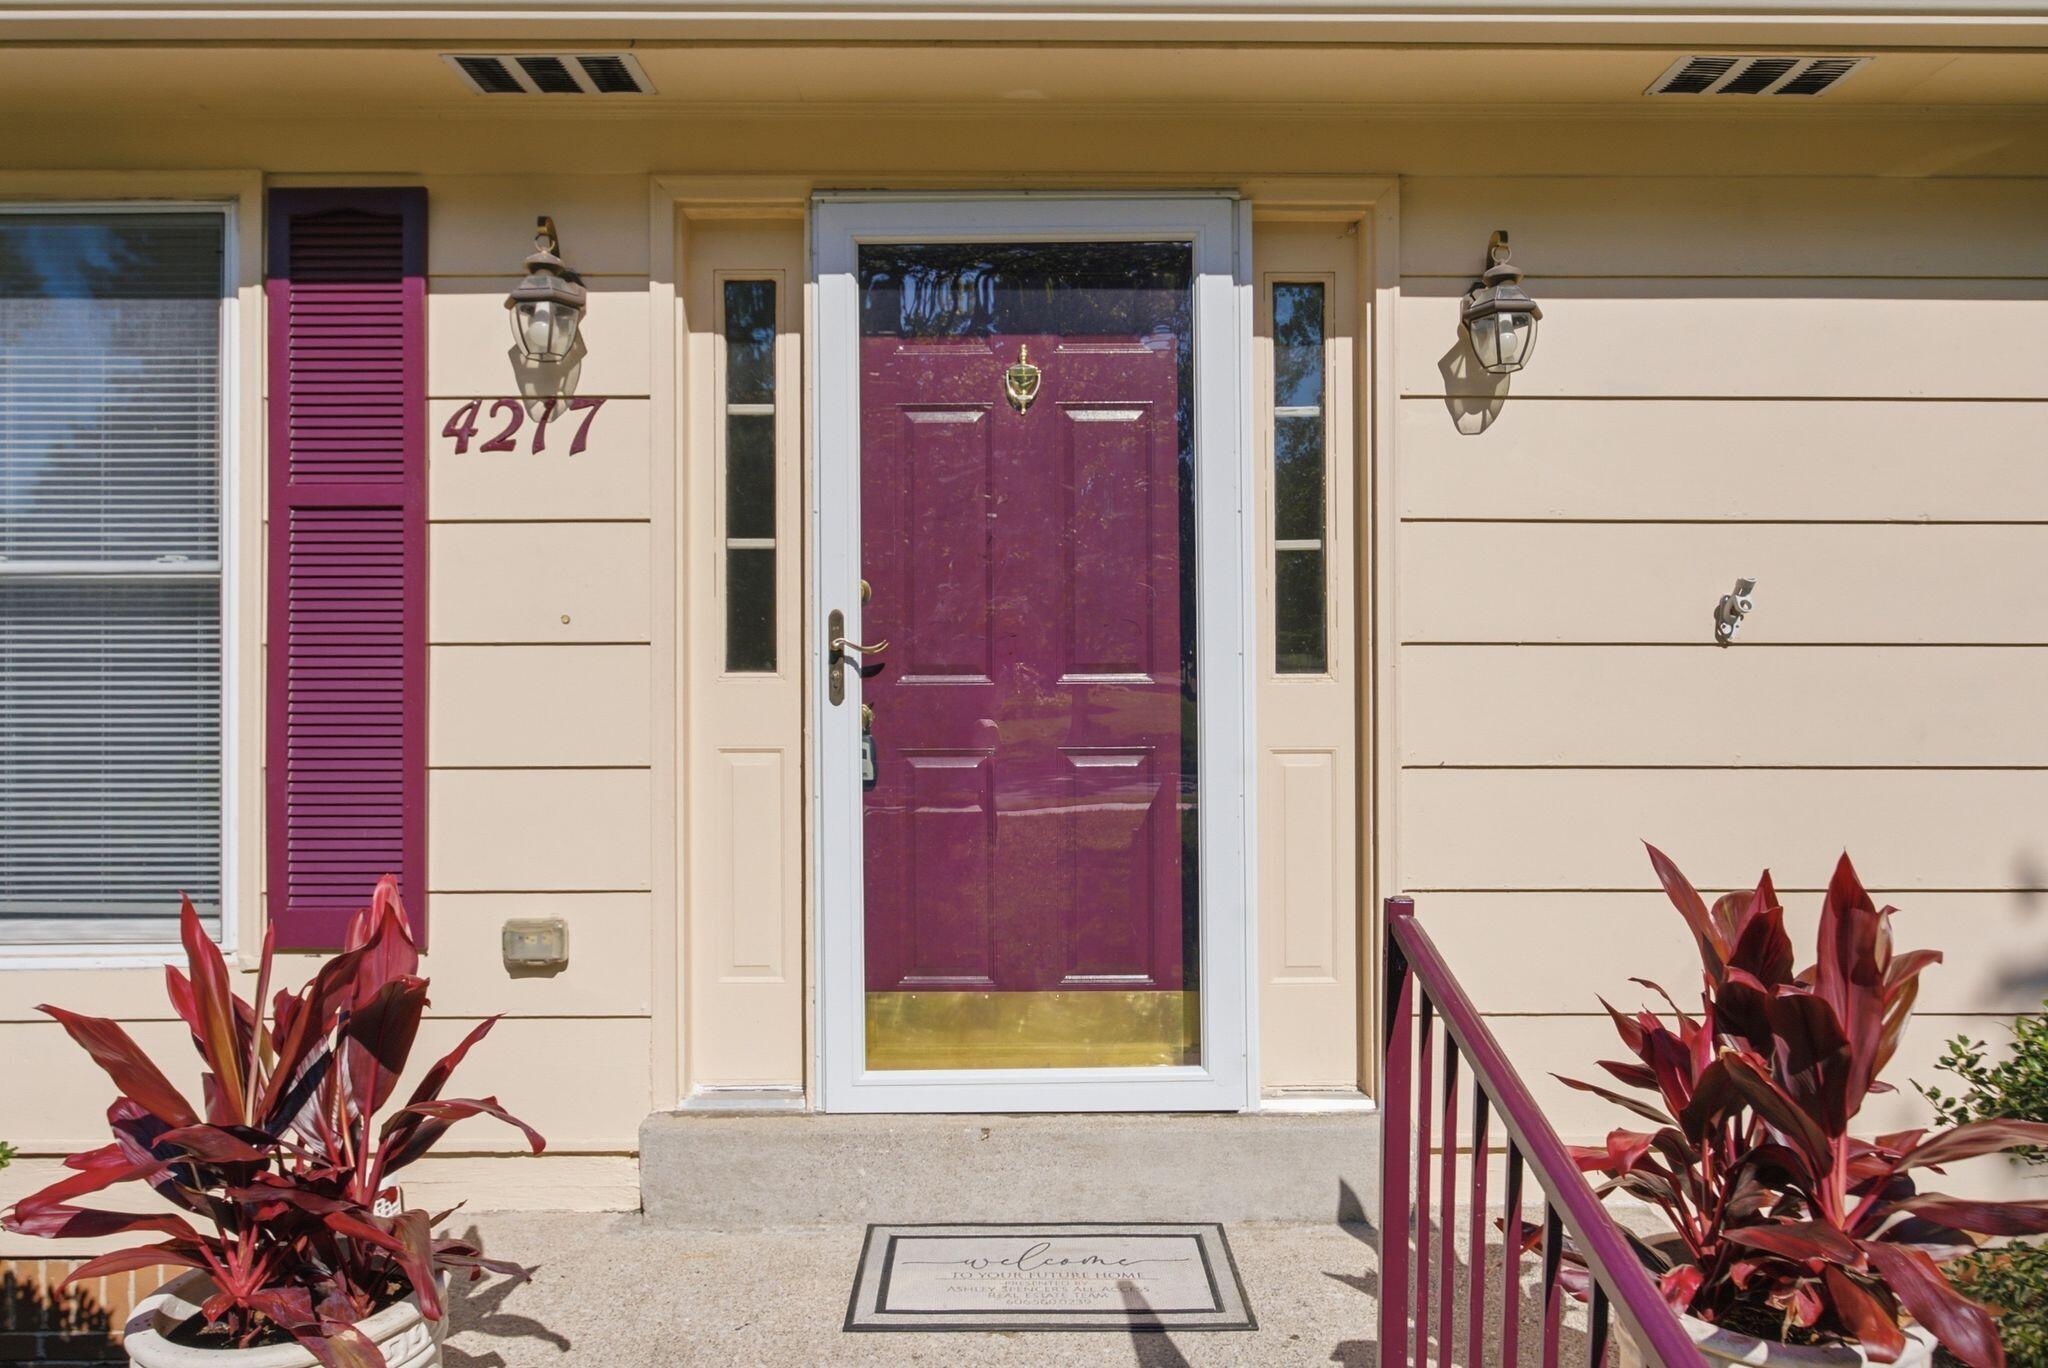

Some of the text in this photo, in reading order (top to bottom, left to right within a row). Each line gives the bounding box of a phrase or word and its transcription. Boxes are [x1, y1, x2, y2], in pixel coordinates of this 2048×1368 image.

[441, 396, 608, 457] 4217
[902, 1242, 1190, 1272] welcome
[952, 1271, 1143, 1279] TO YOUR FUTURE HOME
